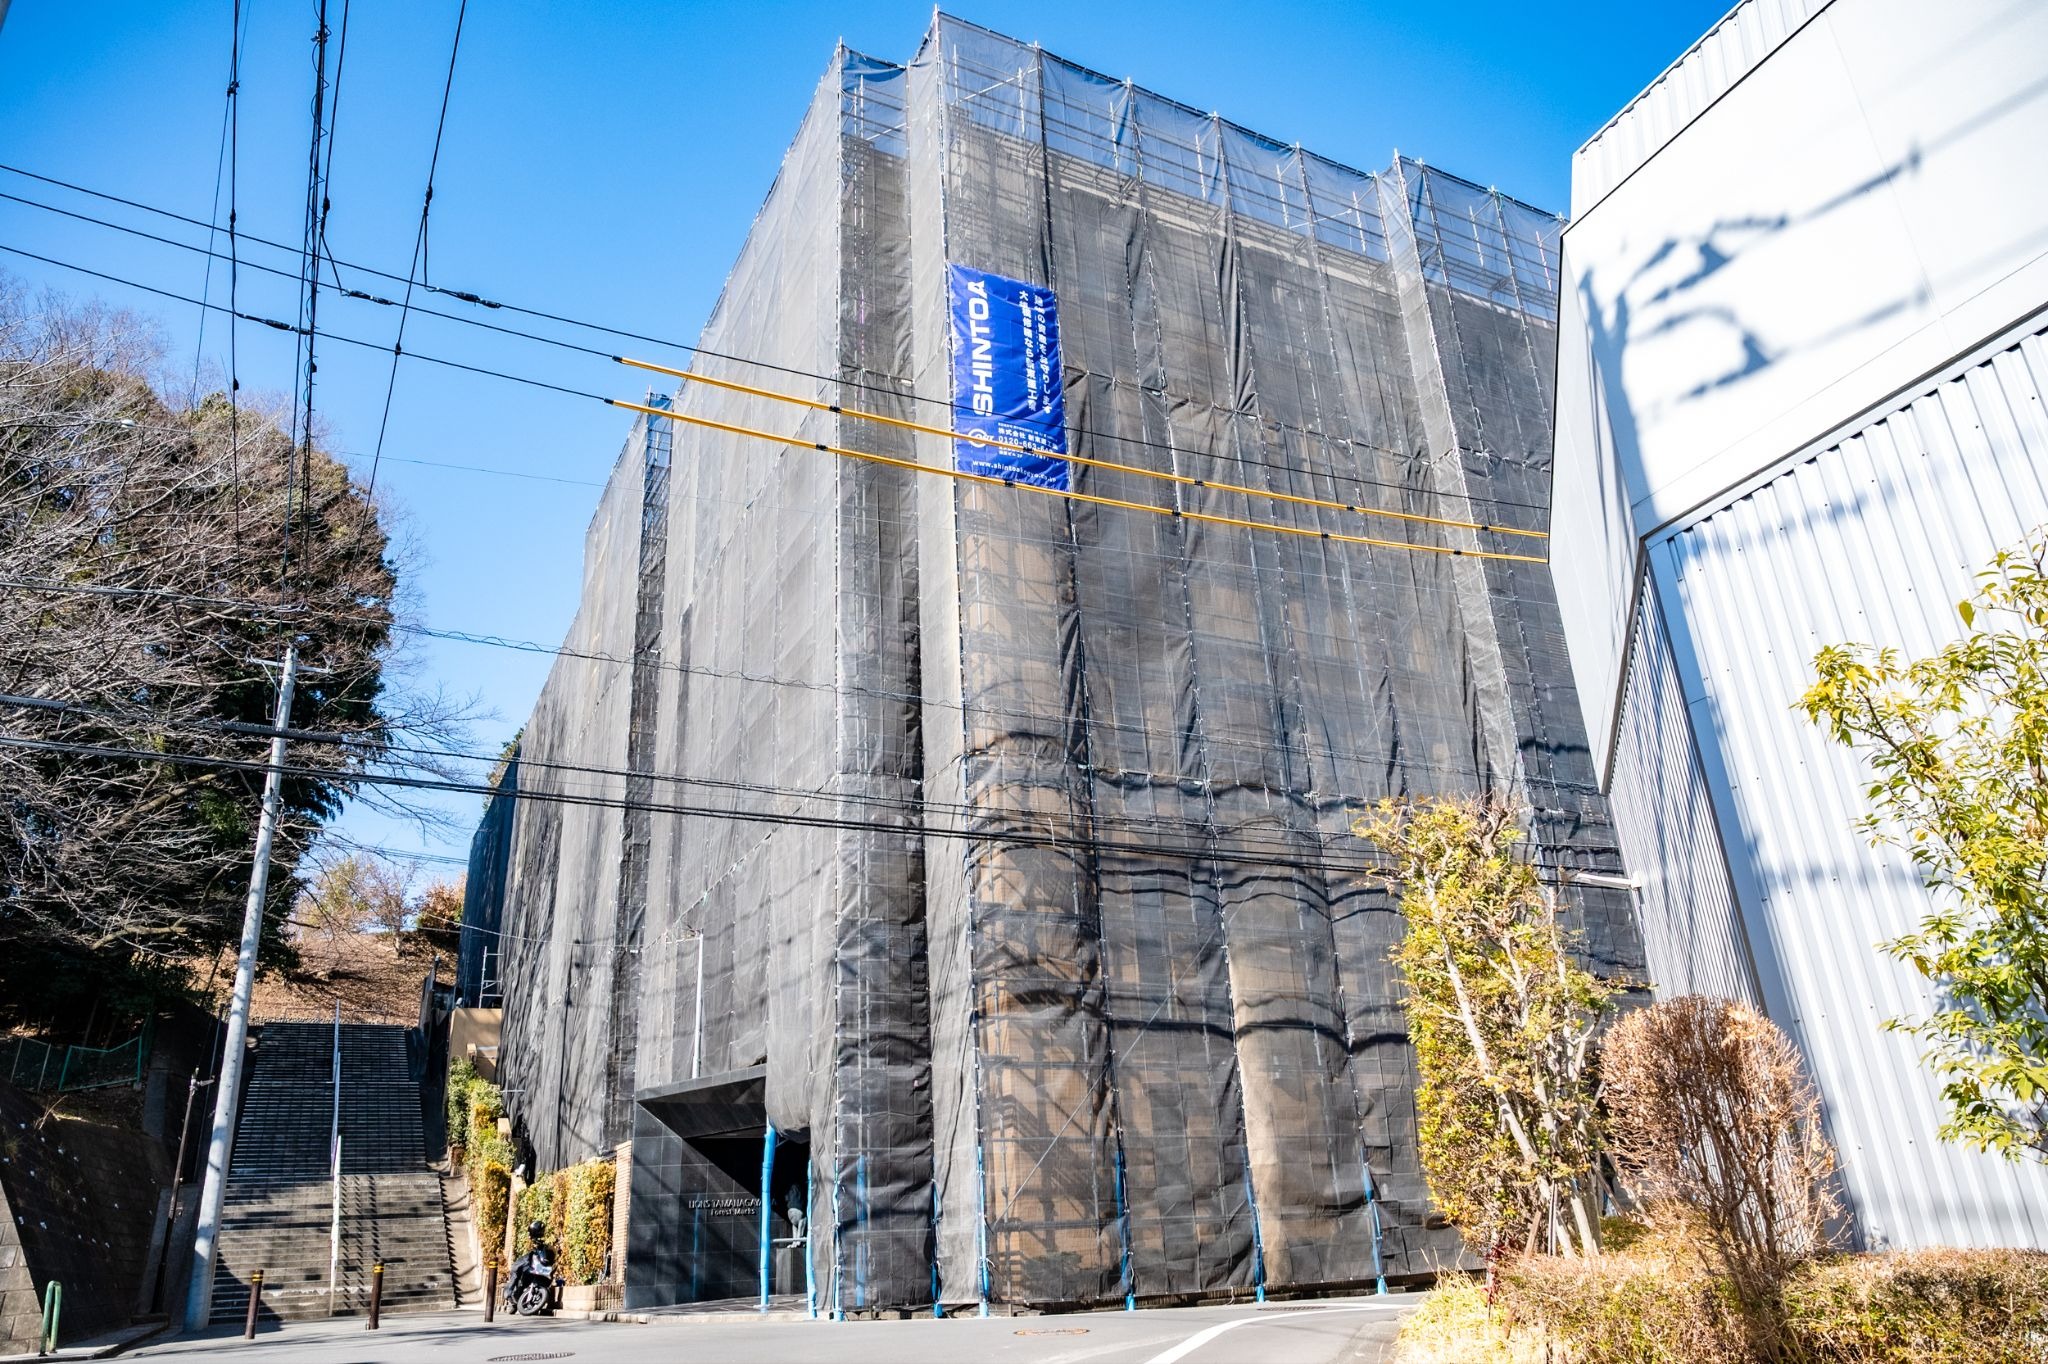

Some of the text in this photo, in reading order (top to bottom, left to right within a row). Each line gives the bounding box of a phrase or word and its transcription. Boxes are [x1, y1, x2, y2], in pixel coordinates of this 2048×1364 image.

[967, 280, 994, 417] SHINTOA
[688, 1199, 710, 1209] LIONS
[710, 1208, 732, 1216] Forest
